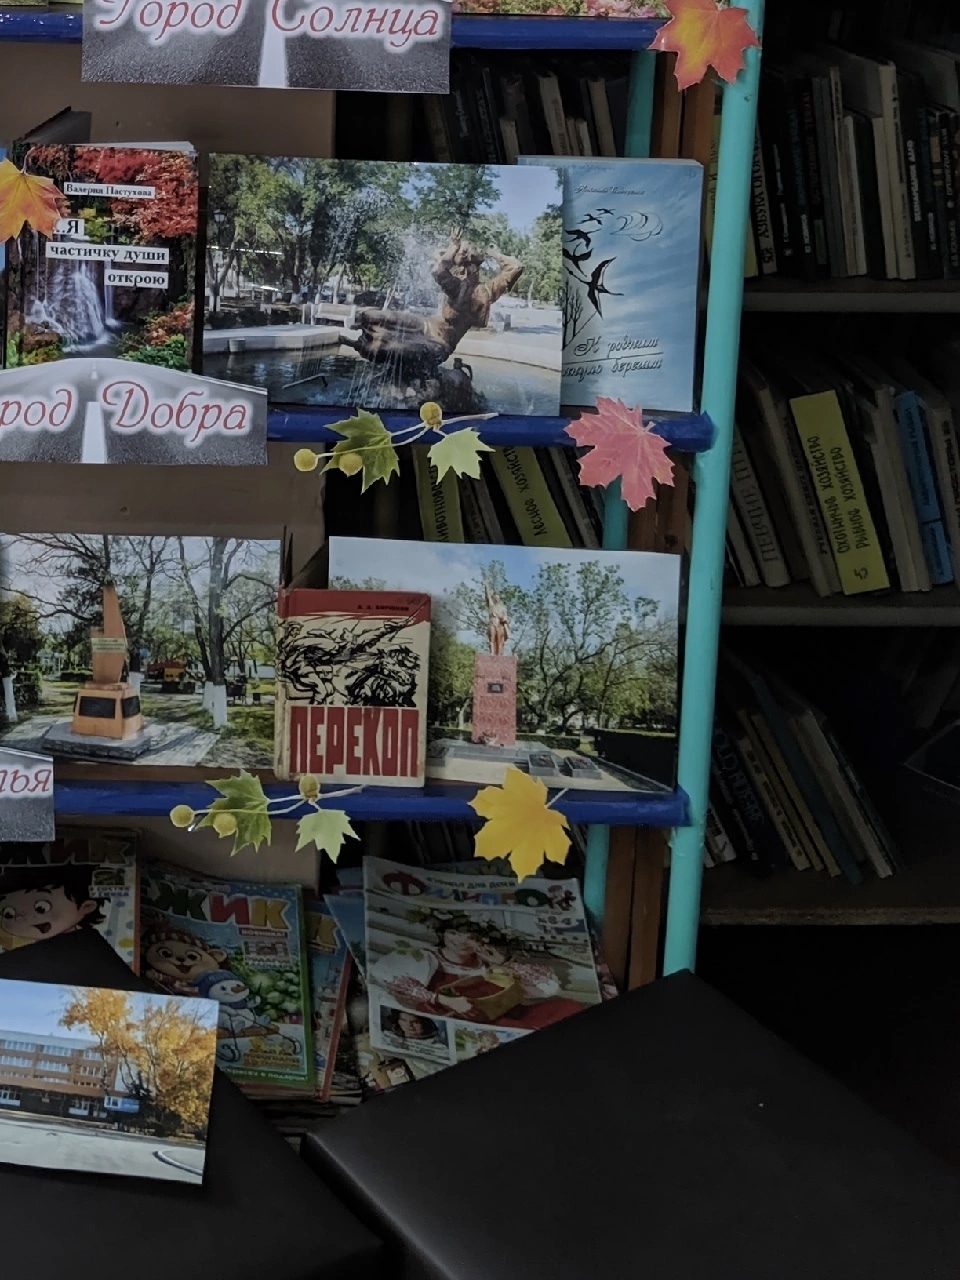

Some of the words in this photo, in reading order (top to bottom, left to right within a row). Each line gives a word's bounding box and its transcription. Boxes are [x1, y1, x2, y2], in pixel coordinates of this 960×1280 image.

[67, 184, 103, 195] Валерия
[106, 186, 152, 197] Пастухова
[50, 246, 119, 261] частичку
[124, 248, 166, 263] души
[107, 273, 166, 288] открою
[102, 380, 247, 443] Добра
[807, 435, 834, 491] ХОЗЯЙСТВО
[830, 447, 856, 501] ХОЗЯЙСТВО
[290, 705, 420, 778] ПЕРЕКОП
